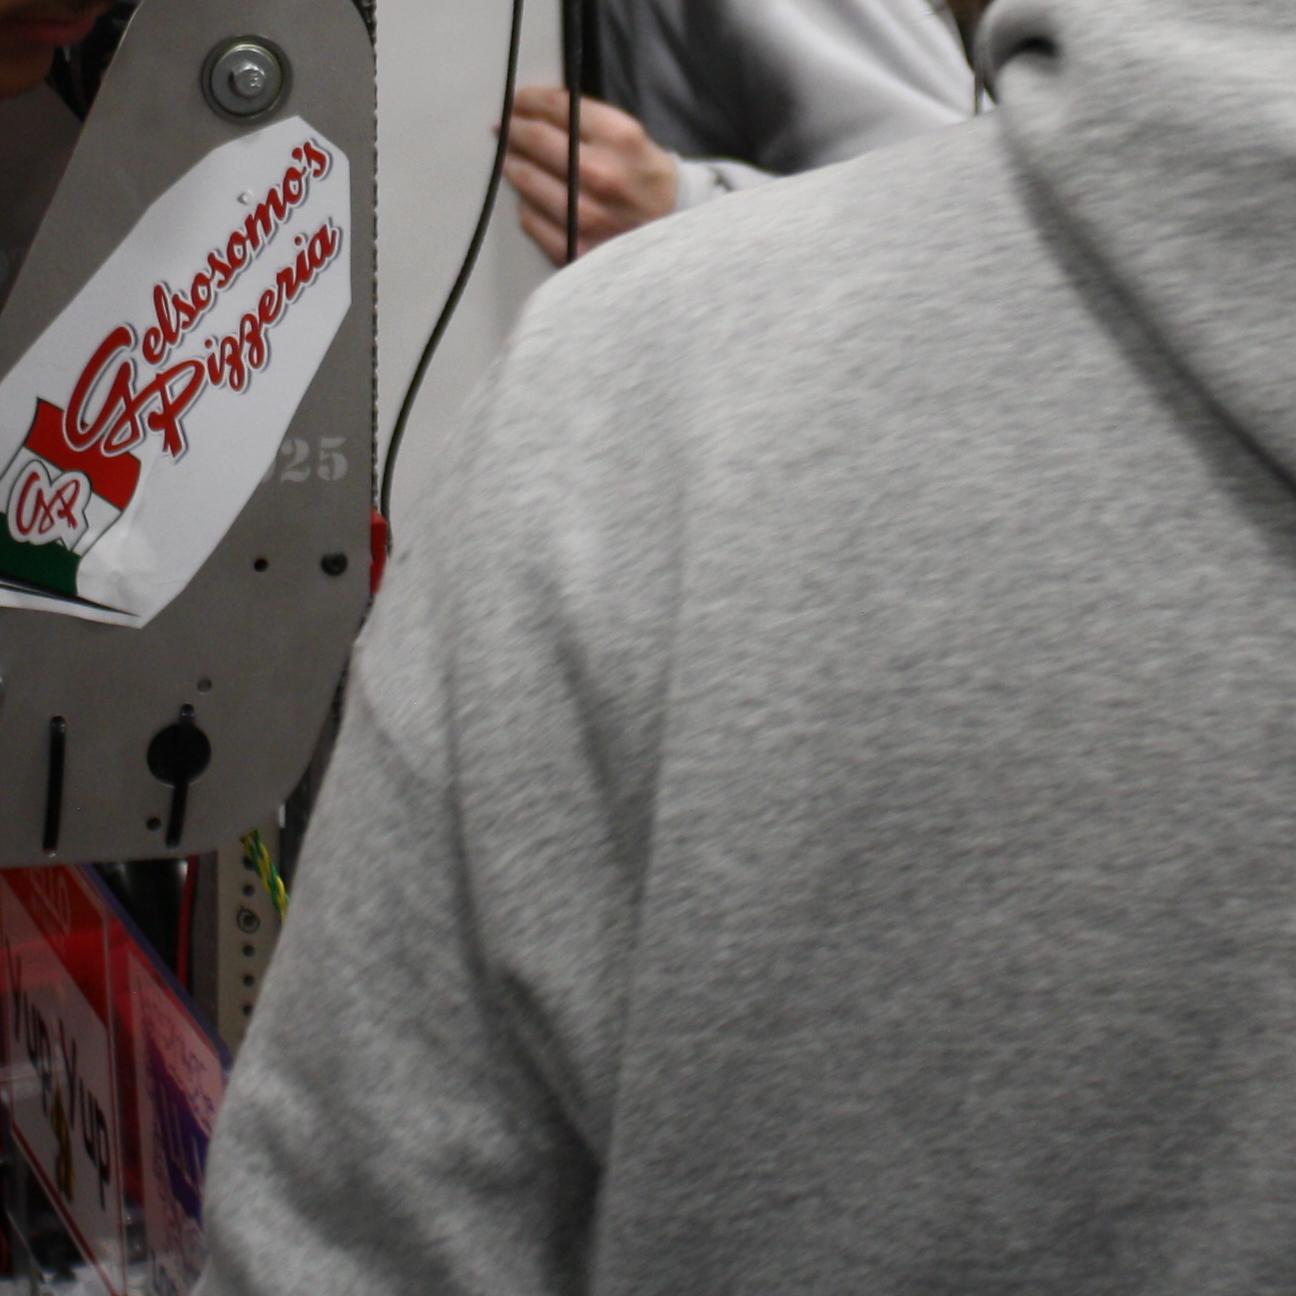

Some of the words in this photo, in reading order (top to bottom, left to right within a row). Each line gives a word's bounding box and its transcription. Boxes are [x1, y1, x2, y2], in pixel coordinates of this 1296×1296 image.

[63, 138, 331, 457] Gelsosomo's
[134, 216, 340, 459] Pizzeria
[264, 436, 350, 482] 25
[58, 1016, 111, 1212] Yup
